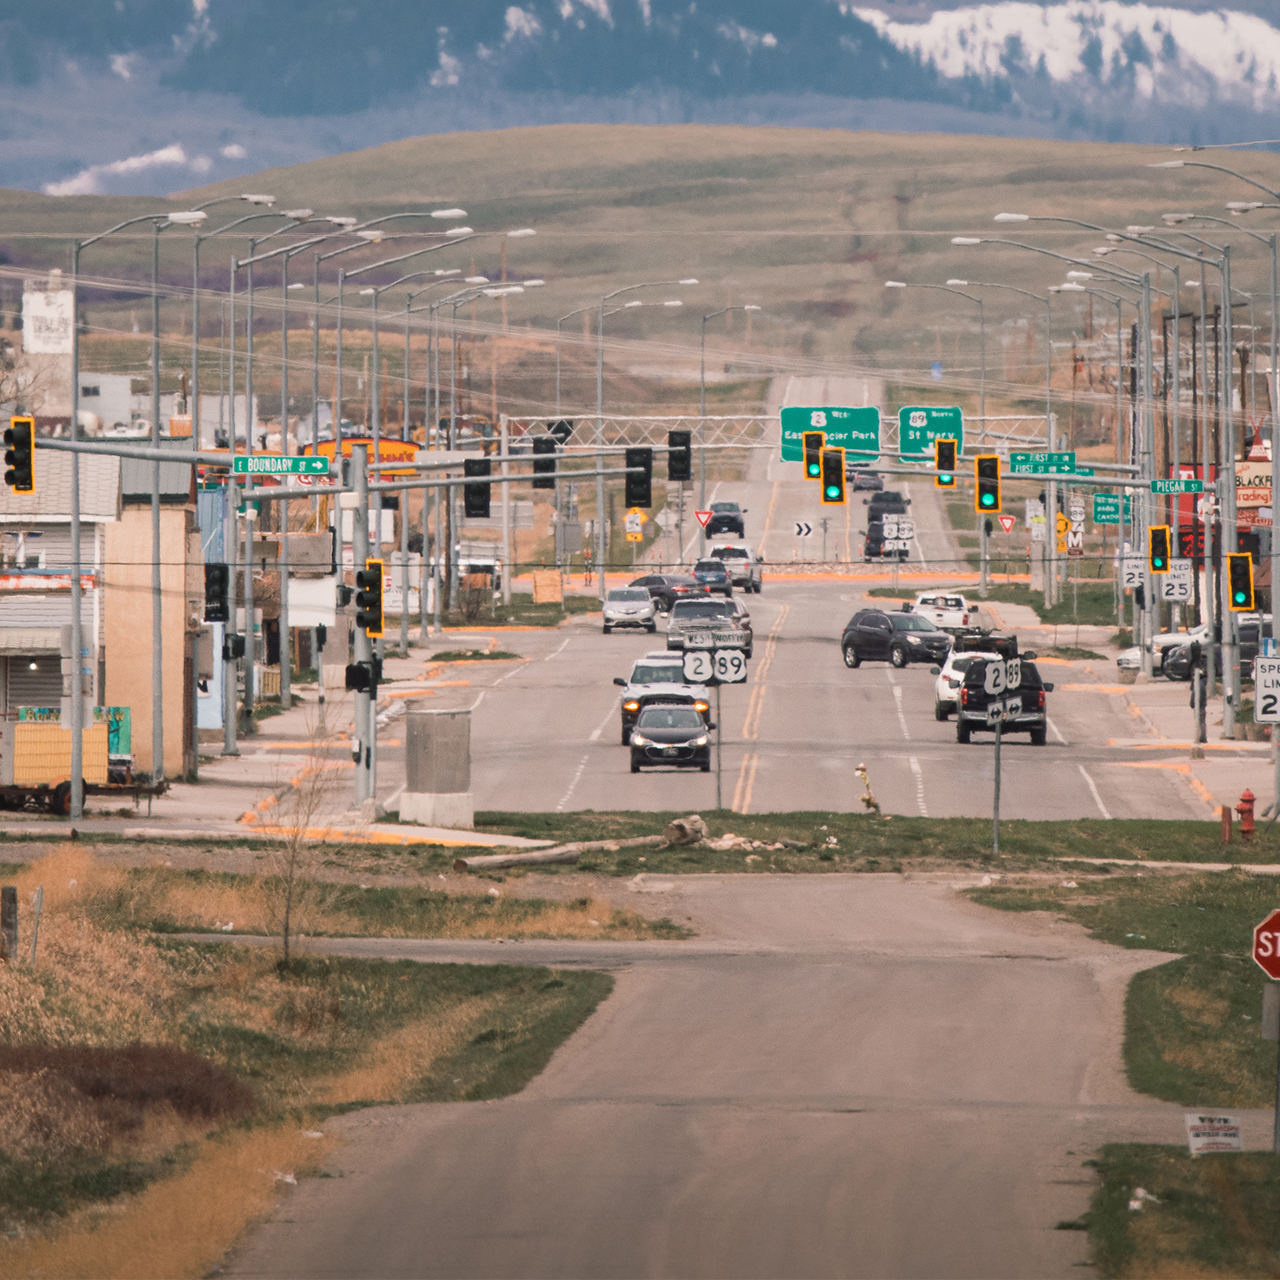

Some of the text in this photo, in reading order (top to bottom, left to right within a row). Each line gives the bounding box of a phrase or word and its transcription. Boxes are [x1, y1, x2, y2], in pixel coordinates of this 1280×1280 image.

[816, 414, 823, 424] 2
[912, 414, 925, 424] 89
[785, 431, 803, 439] Eas
[852, 430, 876, 440] Park
[909, 431, 920, 440] St
[1030, 454, 1048, 462] FIRST
[238, 459, 306, 472] E BOUNDARY ST
[1015, 465, 1033, 473] FIRST
[1157, 481, 1198, 492] PIEGAN ST
[1165, 583, 1189, 597] 25
[687, 633, 711, 644] WEST
[693, 657, 703, 675] 2
[718, 656, 742, 675] 89
[992, 667, 1001, 689] 2
[1008, 663, 1020, 684] 89
